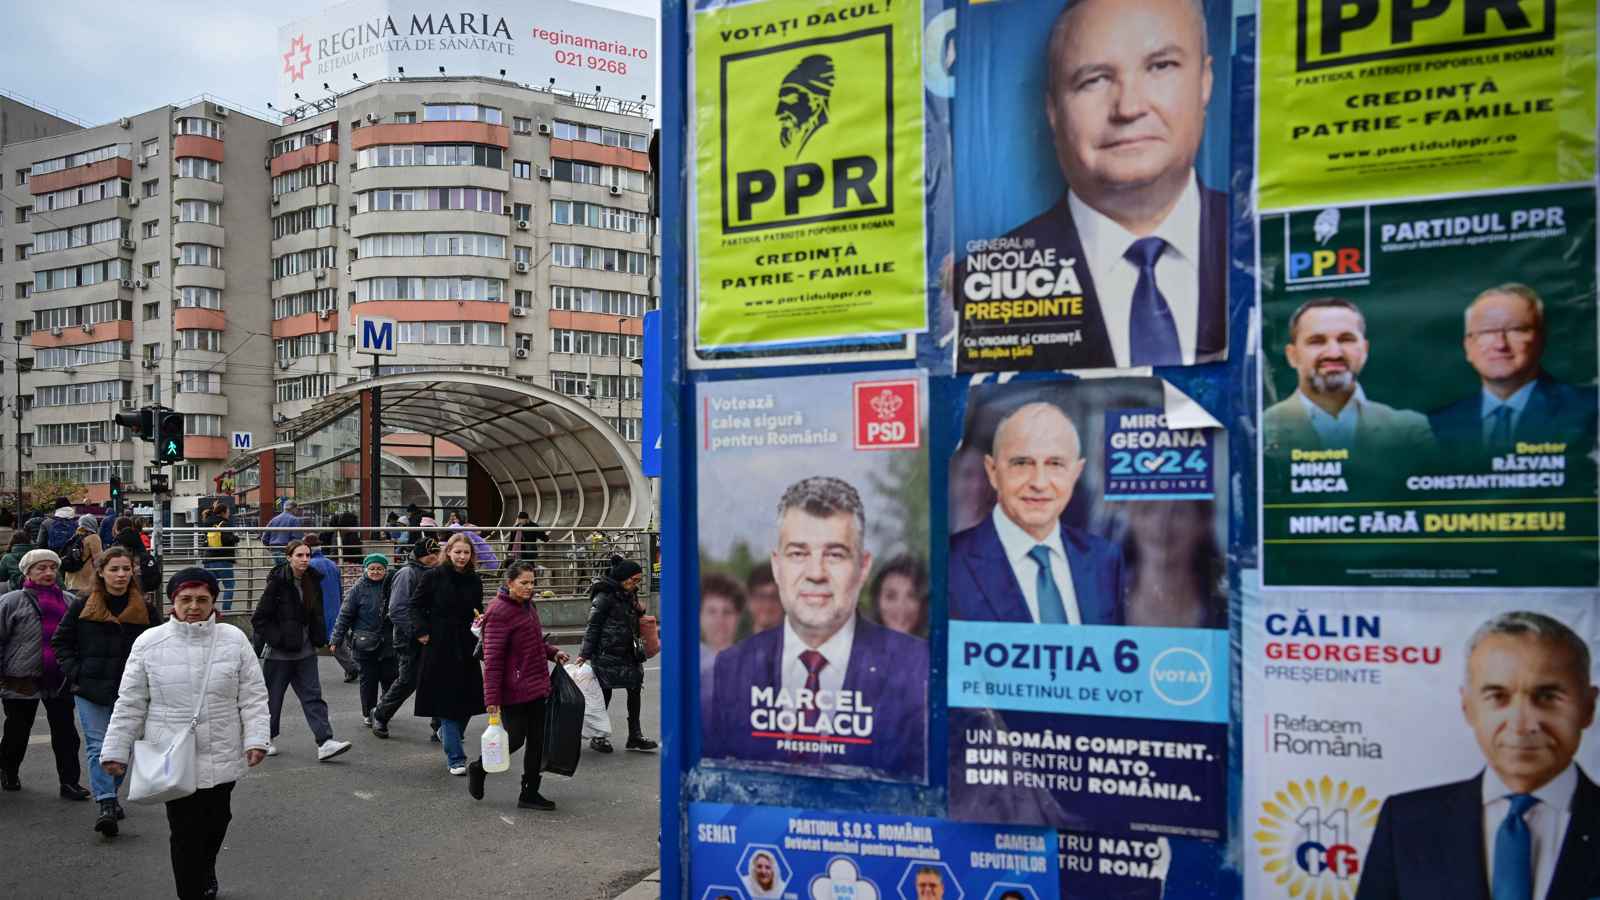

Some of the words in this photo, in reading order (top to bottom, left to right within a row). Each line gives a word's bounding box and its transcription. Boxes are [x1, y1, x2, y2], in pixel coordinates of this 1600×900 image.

[720, 19, 798, 43] VOTAȚI
[806, 4, 880, 27] DACUL
[1319, 0, 1532, 56] PPR
[318, 15, 399, 60] REGINA
[409, 13, 513, 40] MARIA
[415, 39, 436, 51] DE
[440, 36, 515, 56] SĂNĂTATE
[532, 28, 648, 60] reginamaria.ro
[555, 50, 582, 67] 021
[587, 56, 628, 76] 9268
[1296, 69, 1355, 87] PARTIDUL
[1424, 54, 1499, 72] POPORULUI
[1345, 76, 1499, 109] CREDINȚĂ
[1292, 115, 1402, 140] PATRIE
[1424, 98, 1554, 126] FAMILIE
[1327, 133, 1517, 161] www.partidulppr.ro
[737, 155, 878, 223] PPR
[1381, 213, 1507, 243] PARTIDUL
[1511, 206, 1566, 231] PPR
[756, 242, 857, 266] CREDINȚĂ
[966, 237, 1022, 252] GENERAL
[966, 248, 1057, 272] NICOLAE
[1291, 247, 1364, 279] PPR
[721, 272, 794, 290] PATRIE
[809, 261, 896, 281] FAMILIE
[964, 258, 1083, 301] CIUCĂ
[964, 296, 1083, 325] PREȘEDINTE
[363, 319, 392, 351] M
[964, 337, 977, 348] Cu
[979, 335, 1019, 346] ONOARE
[711, 394, 775, 411] Votează
[711, 415, 751, 429] calea
[753, 411, 803, 430] sigură
[866, 421, 906, 443] PSD
[235, 433, 250, 448] M
[711, 432, 764, 449] pentru
[766, 429, 838, 447] România
[1110, 431, 1208, 449] GEOANA
[1516, 442, 1567, 454] Doctor
[1110, 449, 1208, 475] 2024
[1291, 448, 1349, 462] Deputat
[1492, 453, 1566, 472] RĂZVAN
[1291, 461, 1342, 477] MIHAI
[1406, 472, 1566, 490] CONSTANTINESCU
[1291, 477, 1349, 493] LASCA
[1289, 515, 1355, 534] NIMIC
[1359, 510, 1419, 533] FĂRĂ
[1423, 511, 1566, 532] DUMNEZEU!
[1265, 609, 1382, 639] CĂLIN
[963, 641, 1102, 682] POZIȚIA
[1113, 639, 1140, 674] 6
[1265, 642, 1442, 665] GEORGESCU
[1154, 670, 1209, 683] VOTAT
[1264, 665, 1382, 685] PREȘEDINTE
[751, 686, 873, 714] MARCEL
[962, 681, 980, 695] PE
[985, 682, 1073, 701] BULETINUL
[1079, 687, 1101, 702] DE
[1106, 689, 1144, 704] VOT
[751, 709, 873, 738] CIOLACU
[1273, 713, 1363, 734] Refacem
[966, 729, 992, 745] UN
[997, 730, 1071, 751] ROMÂN
[1075, 736, 1214, 761] COMPETENT.
[1273, 733, 1383, 760] România
[966, 748, 1008, 765] BUN
[1013, 752, 1082, 772] PENTRU
[1088, 757, 1156, 778] NATO.
[966, 769, 1008, 785] BUN
[1013, 772, 1082, 792] PENTRU
[1088, 777, 1201, 802] ROMÂNIA.
[698, 823, 737, 845] SENAT
[788, 818, 841, 837] PARTIDUL
[842, 821, 876, 840] S.O.S.
[878, 822, 933, 843] ROMÂNIA
[995, 832, 1046, 852] CAMERA
[1057, 834, 1093, 852] TRU
[970, 850, 1047, 876] DEPUTAȚILOR
[1057, 853, 1093, 872] TRU
